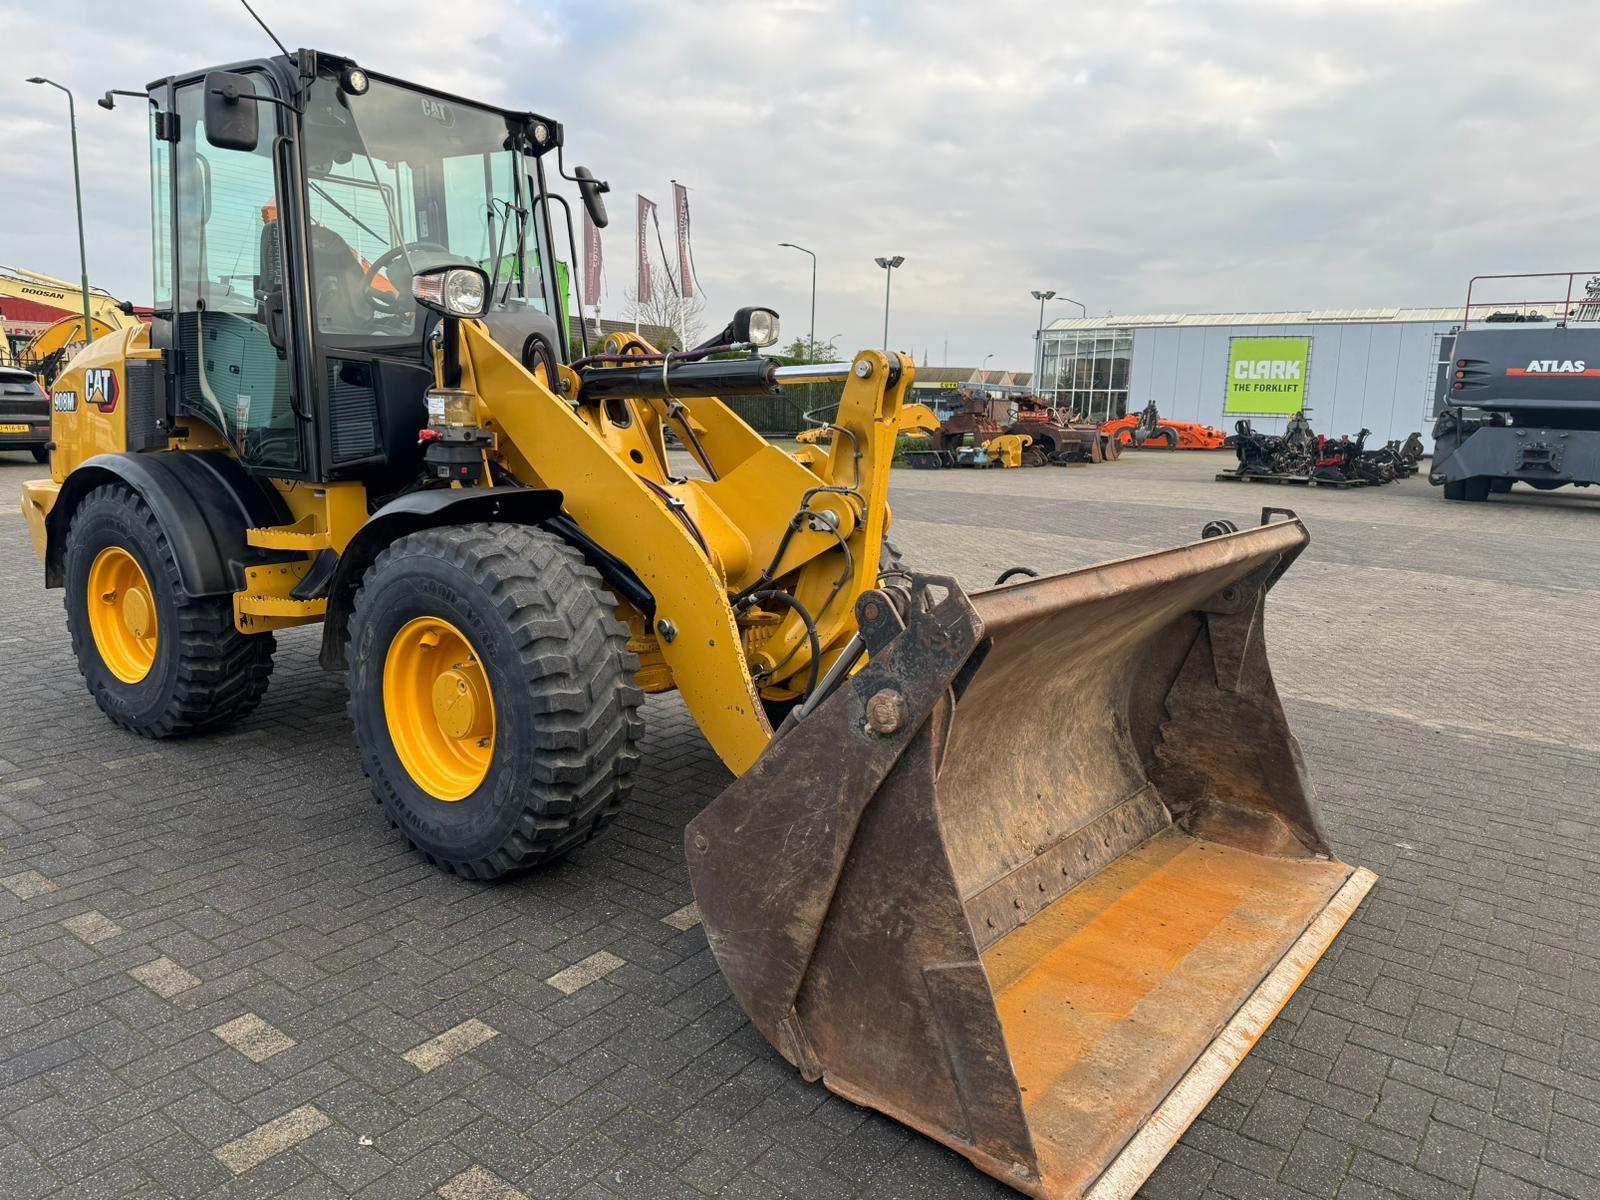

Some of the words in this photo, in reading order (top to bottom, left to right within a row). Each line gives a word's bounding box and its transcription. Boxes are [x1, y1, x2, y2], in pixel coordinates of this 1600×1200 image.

[421, 98, 446, 121] CAT
[21, 287, 65, 300] DOOSAN
[1234, 360, 1301, 380] CLARK
[1525, 359, 1586, 373] ATLAS
[85, 369, 111, 403] CAT
[1233, 383, 1251, 392] THE
[1253, 383, 1299, 393] FORKLIFT
[54, 391, 75, 411] 908M
